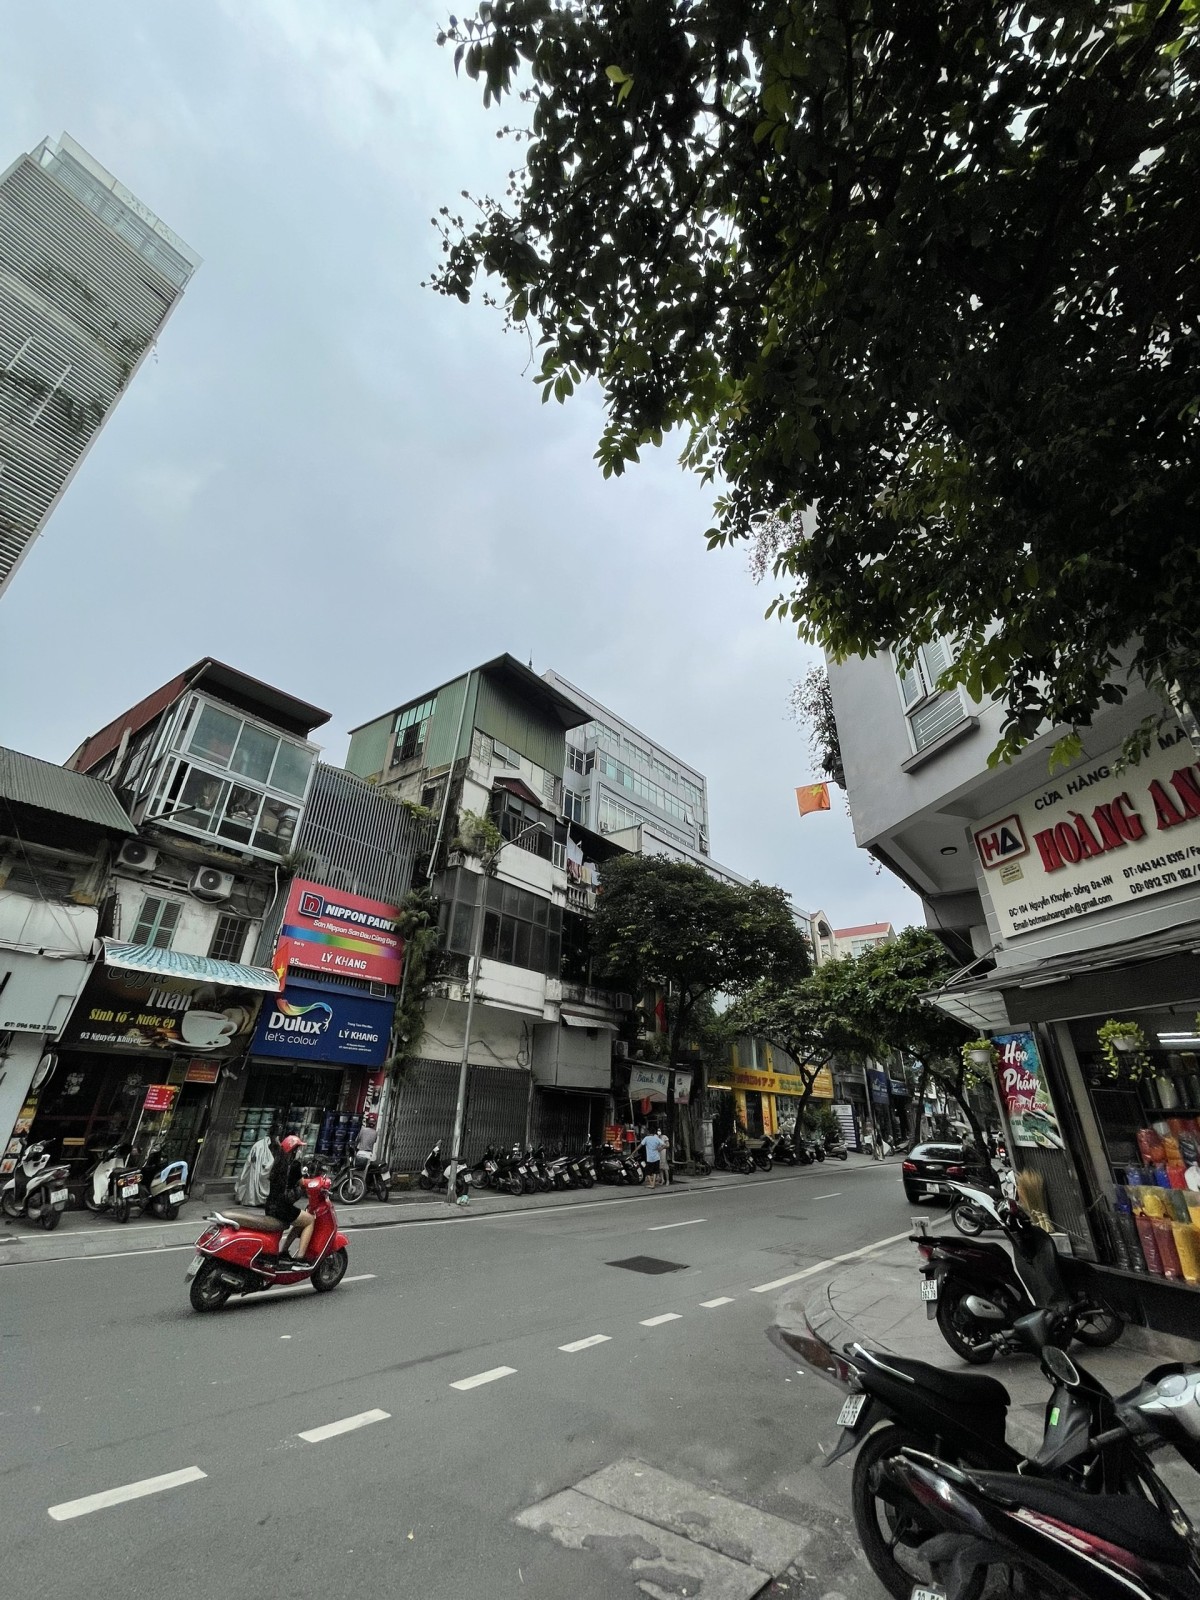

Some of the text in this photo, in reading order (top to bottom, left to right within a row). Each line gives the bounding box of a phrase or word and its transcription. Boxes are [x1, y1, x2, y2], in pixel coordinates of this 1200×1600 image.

[1034, 790, 1063, 810] CỬA
[1066, 766, 1110, 795] HÀNG
[1033, 761, 1200, 872] HOÀNG AN
[325, 904, 397, 931] NIPPON PAINT
[289, 957, 299, 965] 95
[321, 951, 367, 969] LÝ KHANG
[145, 986, 192, 1011] Tuấn
[89, 1008, 113, 1022] Sinh
[115, 1010, 131, 1023] tố
[135, 1013, 161, 1027] Nước
[162, 1015, 176, 1029] ép
[268, 1011, 322, 1034] Dulux
[264, 1031, 318, 1046] let's colour
[339, 1029, 378, 1042] LÝ KHANG
[1003, 1068, 1041, 1093] Phẩm
